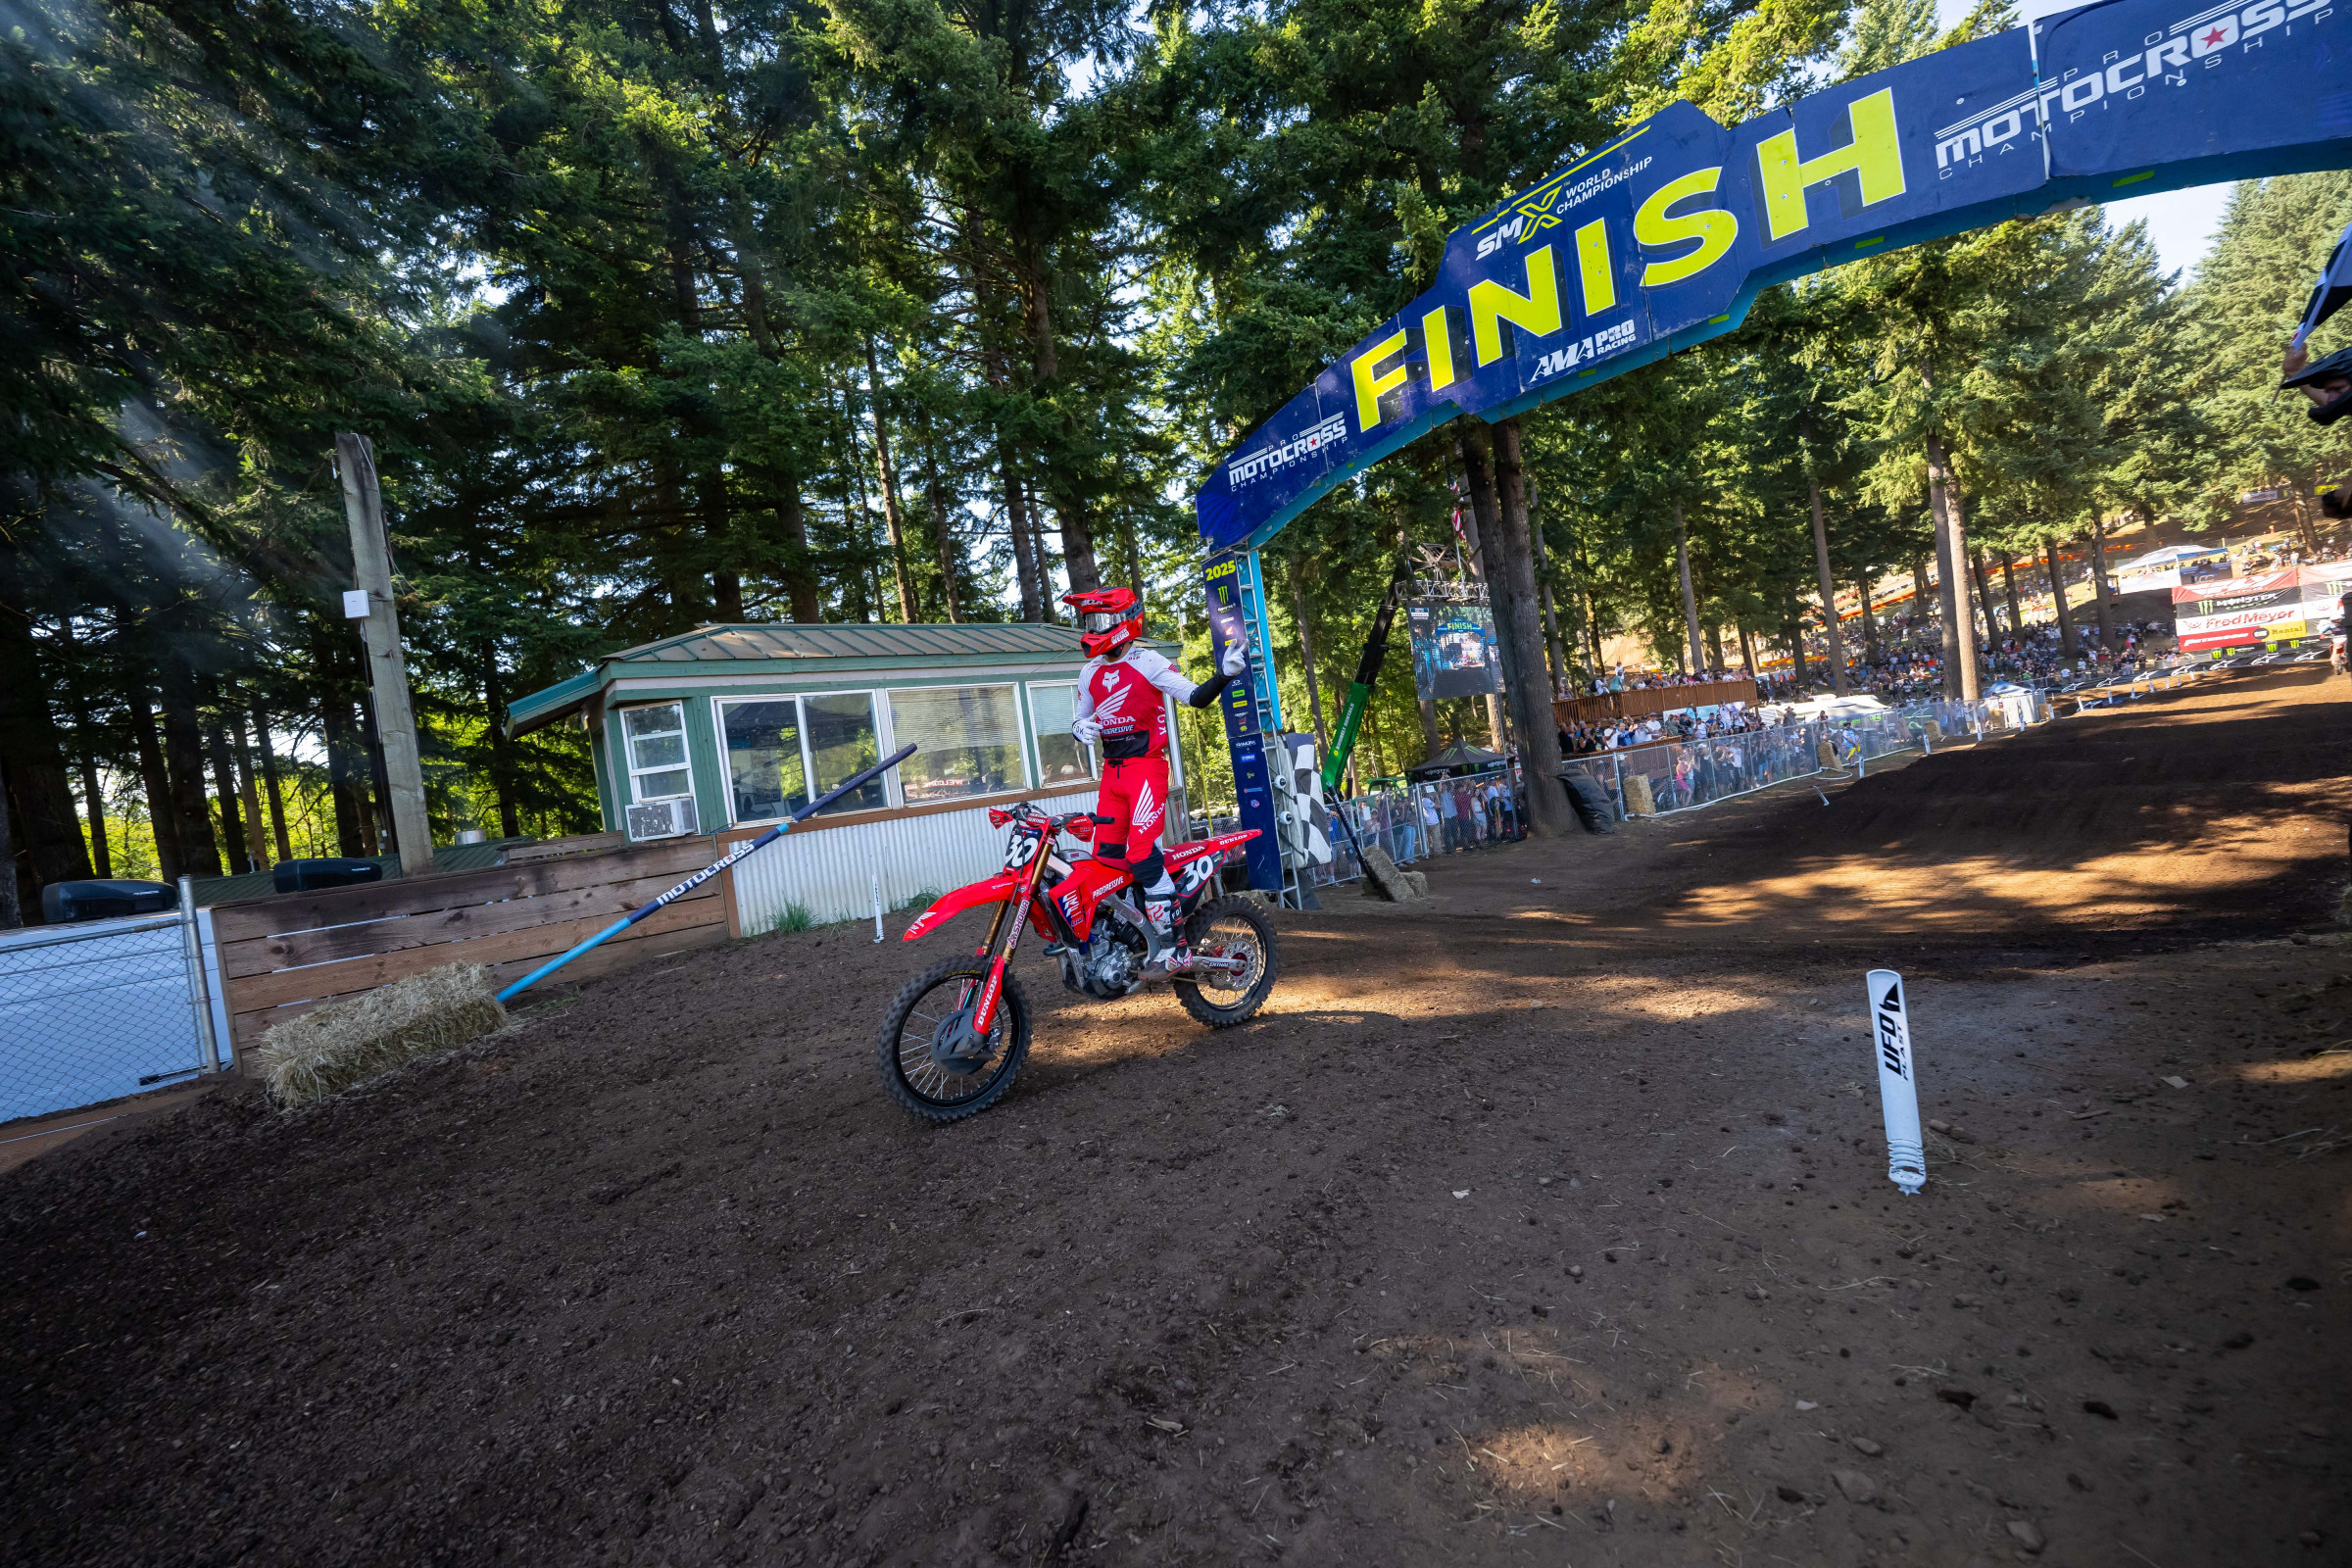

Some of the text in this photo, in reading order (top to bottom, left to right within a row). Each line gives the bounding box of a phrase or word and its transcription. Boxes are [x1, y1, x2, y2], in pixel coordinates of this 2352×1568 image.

[2063, 30, 2164, 81] PRO
[1939, 8, 2333, 180] CHAMPIONSHIP
[1556, 156, 1652, 215] CHAMPIONSHIP
[1565, 168, 1611, 198] WORLD
[1475, 184, 1563, 262] SMX
[1350, 86, 1906, 433] FINISH
[1594, 318, 1635, 347] PRO
[1596, 334, 1636, 355] RACING
[1529, 336, 1594, 383] AMA
[1229, 418, 1347, 486] MOTOCROSS
[1268, 433, 1298, 452] PRO
[1231, 436, 1348, 492] CHAMPIONSHIP
[1204, 560, 1236, 582] 2025
[1138, 802, 1165, 835] HONDA
[1005, 834, 1039, 867] 30
[1171, 845, 1205, 860] HONDA
[1219, 834, 1248, 846] DUNLOP
[656, 842, 755, 906] MOTOCROSS
[1092, 875, 1124, 900] PROGRESSIVE
[1183, 855, 1213, 892] 30
[1015, 900, 1030, 936] SHOWA
[977, 975, 997, 1026] DUNLOP
[1879, 1011, 1901, 1076] UFO
[1896, 1025, 1909, 1081] PLAST
